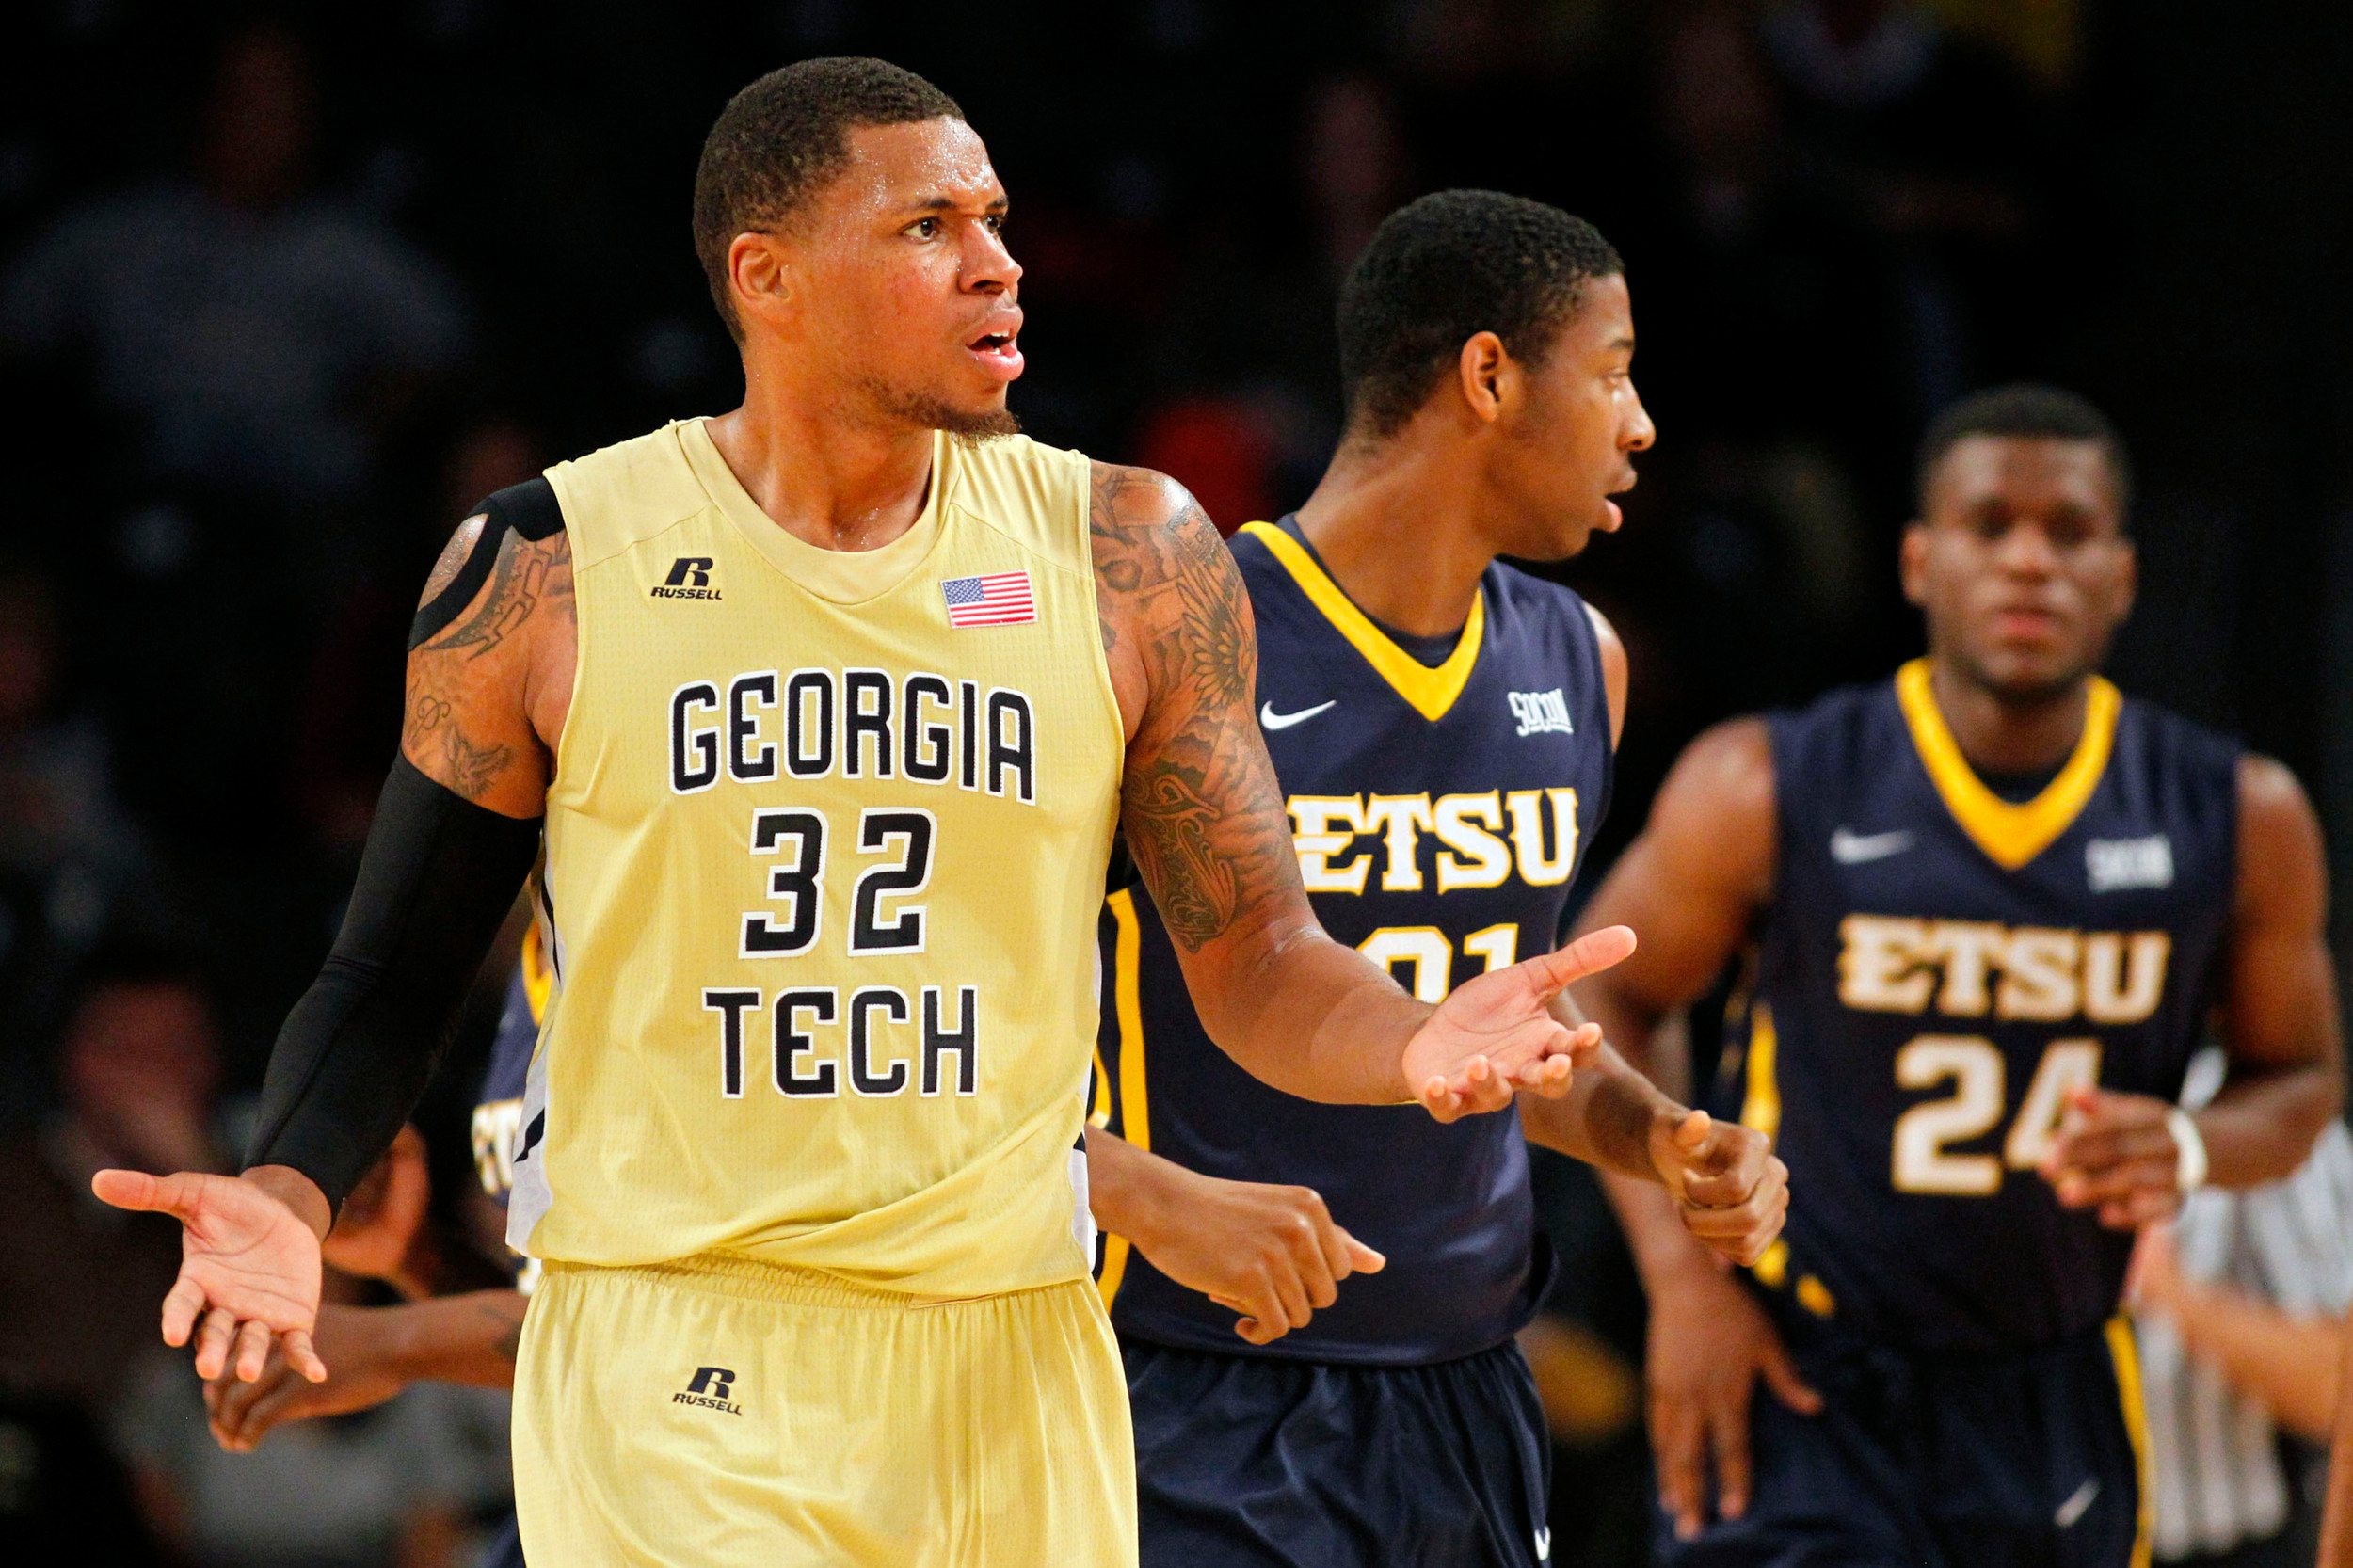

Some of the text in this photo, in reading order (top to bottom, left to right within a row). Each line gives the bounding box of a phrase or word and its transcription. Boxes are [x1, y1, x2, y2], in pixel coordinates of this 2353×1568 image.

[650, 586, 722, 600] RUSSELL
[668, 666, 1036, 806] GEORGIA
[738, 806, 937, 958] 32
[1286, 788, 1579, 896] ETSU
[1837, 913, 2171, 1024] ETSU
[700, 984, 979, 1098] TECH
[1892, 1034, 2103, 1195] 24
[672, 1393, 742, 1416] RUSSELL
